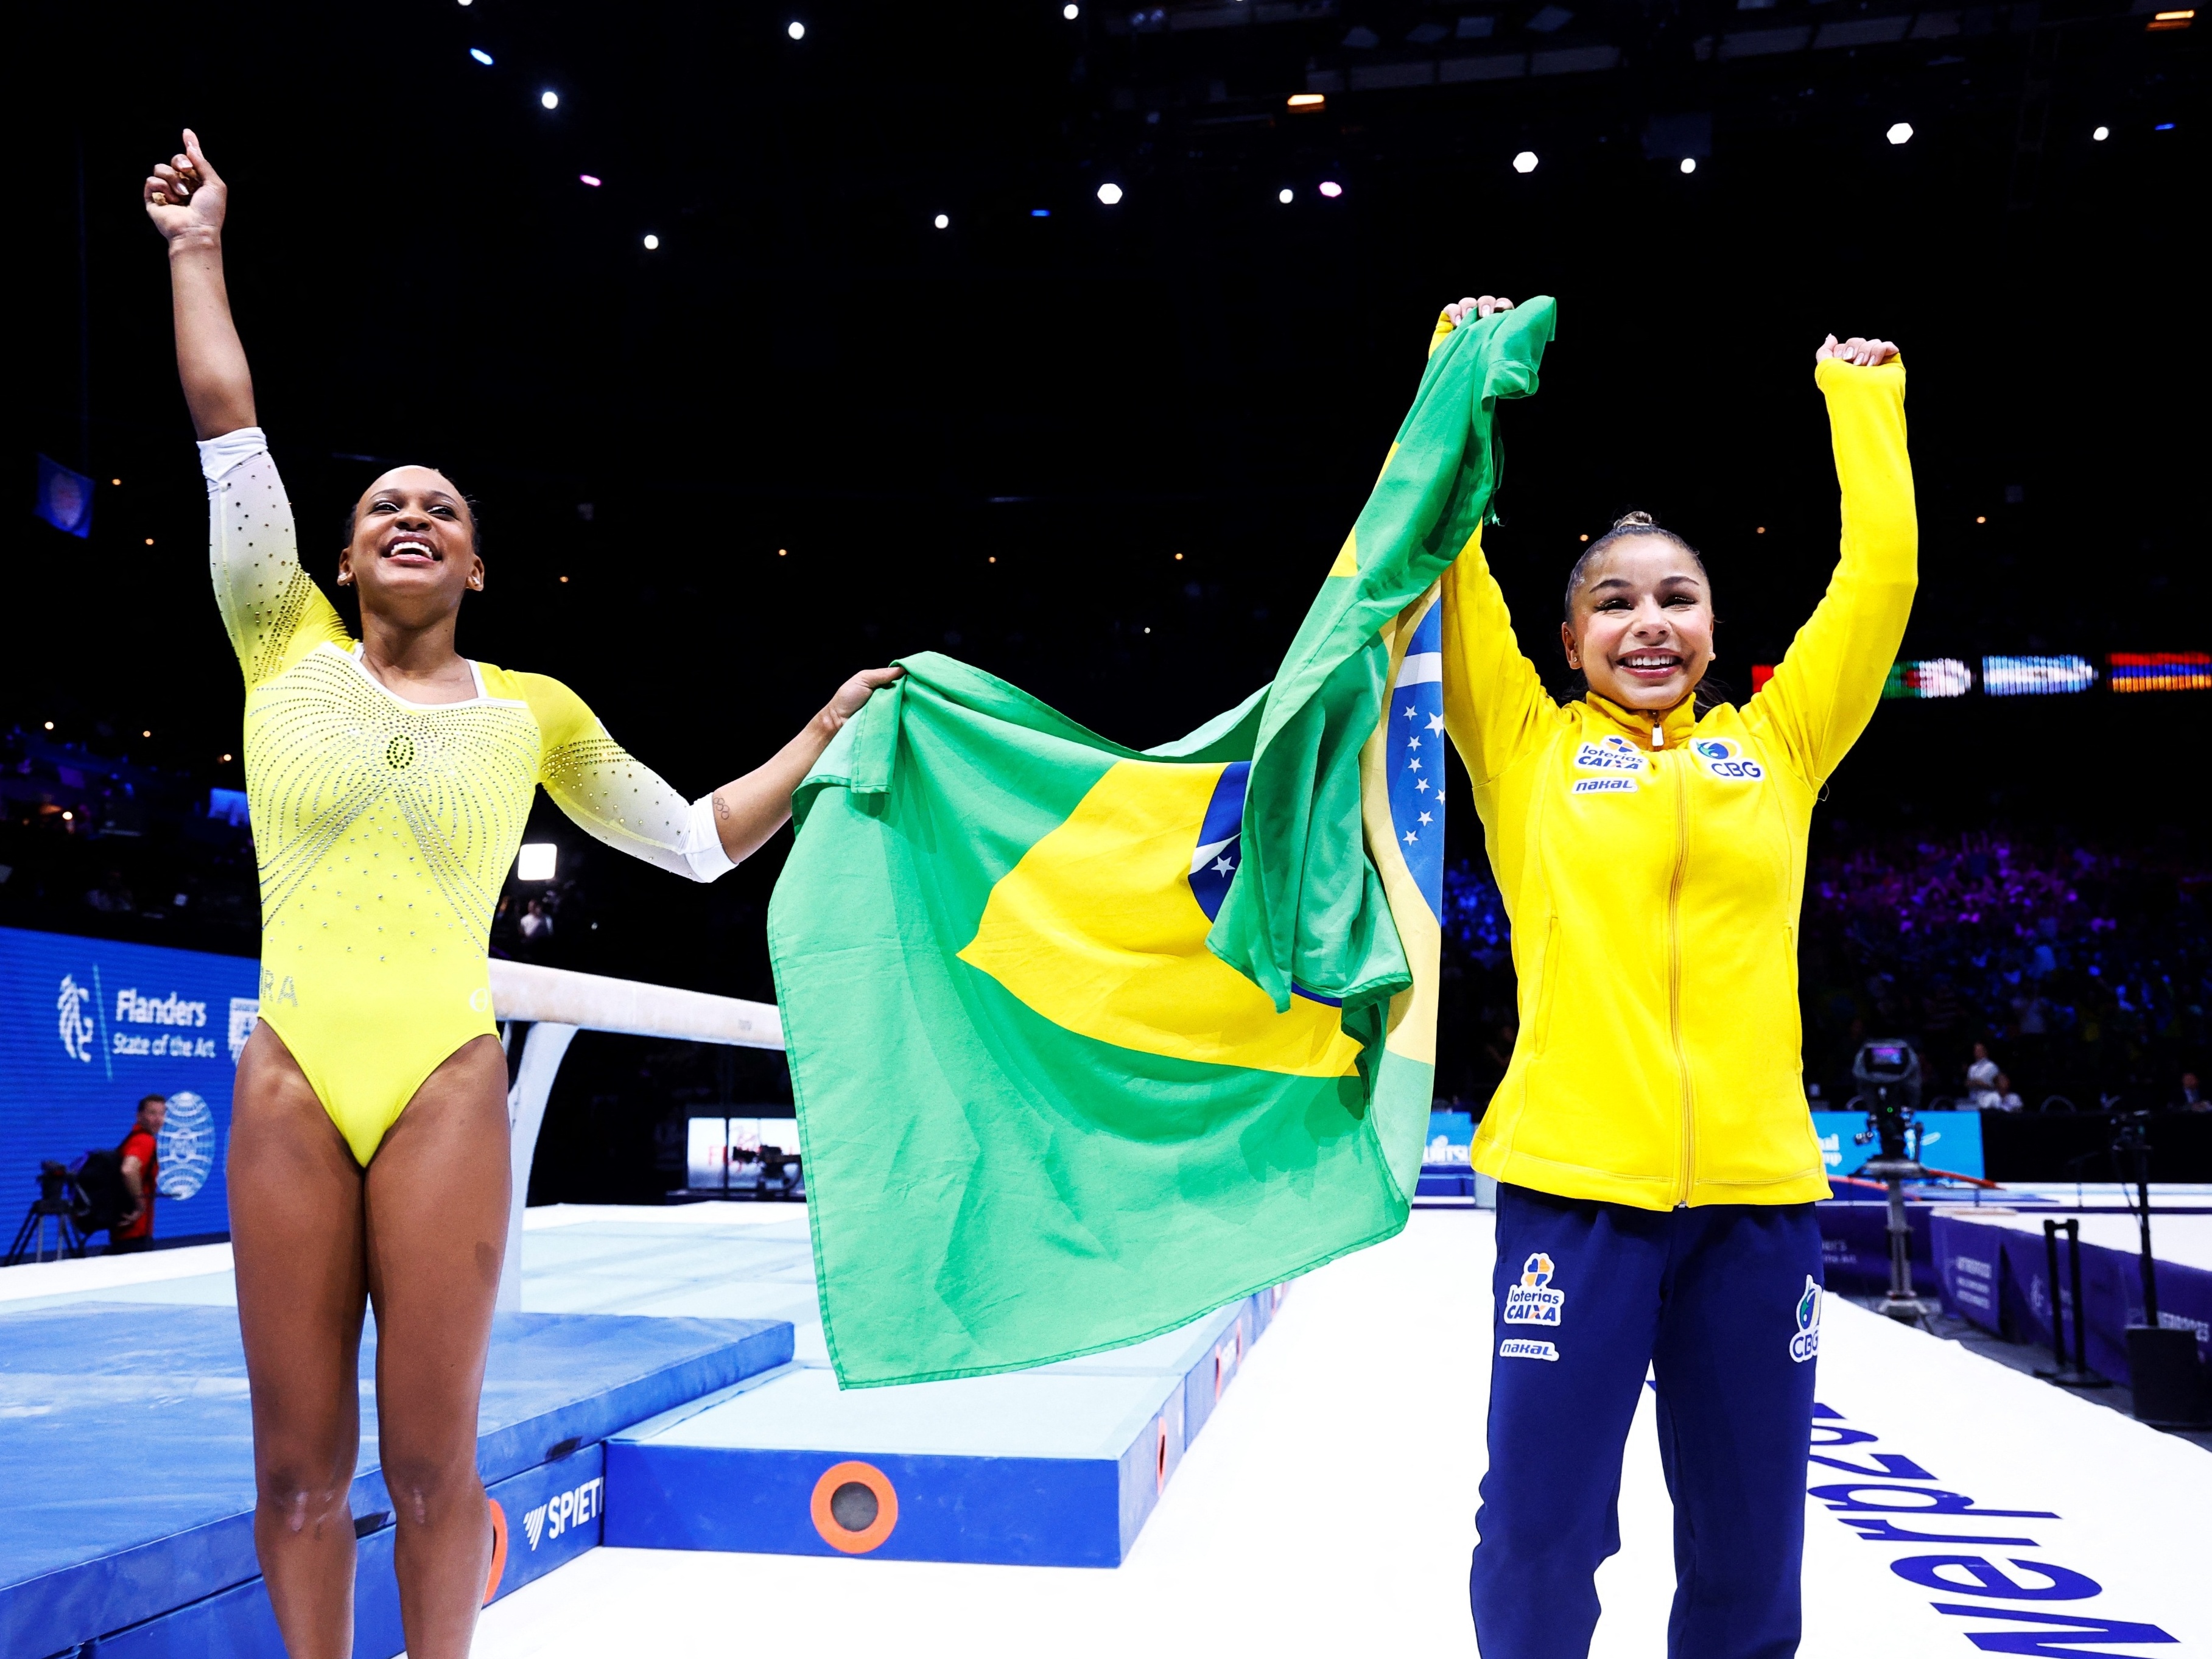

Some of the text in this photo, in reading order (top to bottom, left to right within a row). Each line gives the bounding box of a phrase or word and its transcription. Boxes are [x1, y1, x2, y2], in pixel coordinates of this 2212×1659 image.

[1578, 756, 1639, 770] CAIXA
[1582, 745, 1644, 763] loterias
[1711, 762, 1761, 778] CBG
[260, 966, 298, 1008] RA
[116, 987, 207, 1028] Flanders
[111, 1033, 150, 1055] State
[152, 1034, 169, 1056] of
[170, 1036, 193, 1057] the
[1510, 1288, 1559, 1305] loterias
[1507, 1305, 1556, 1322] CAIXA
[1792, 1330, 1818, 1358] CBG
[548, 1476, 604, 1540] SPIET
